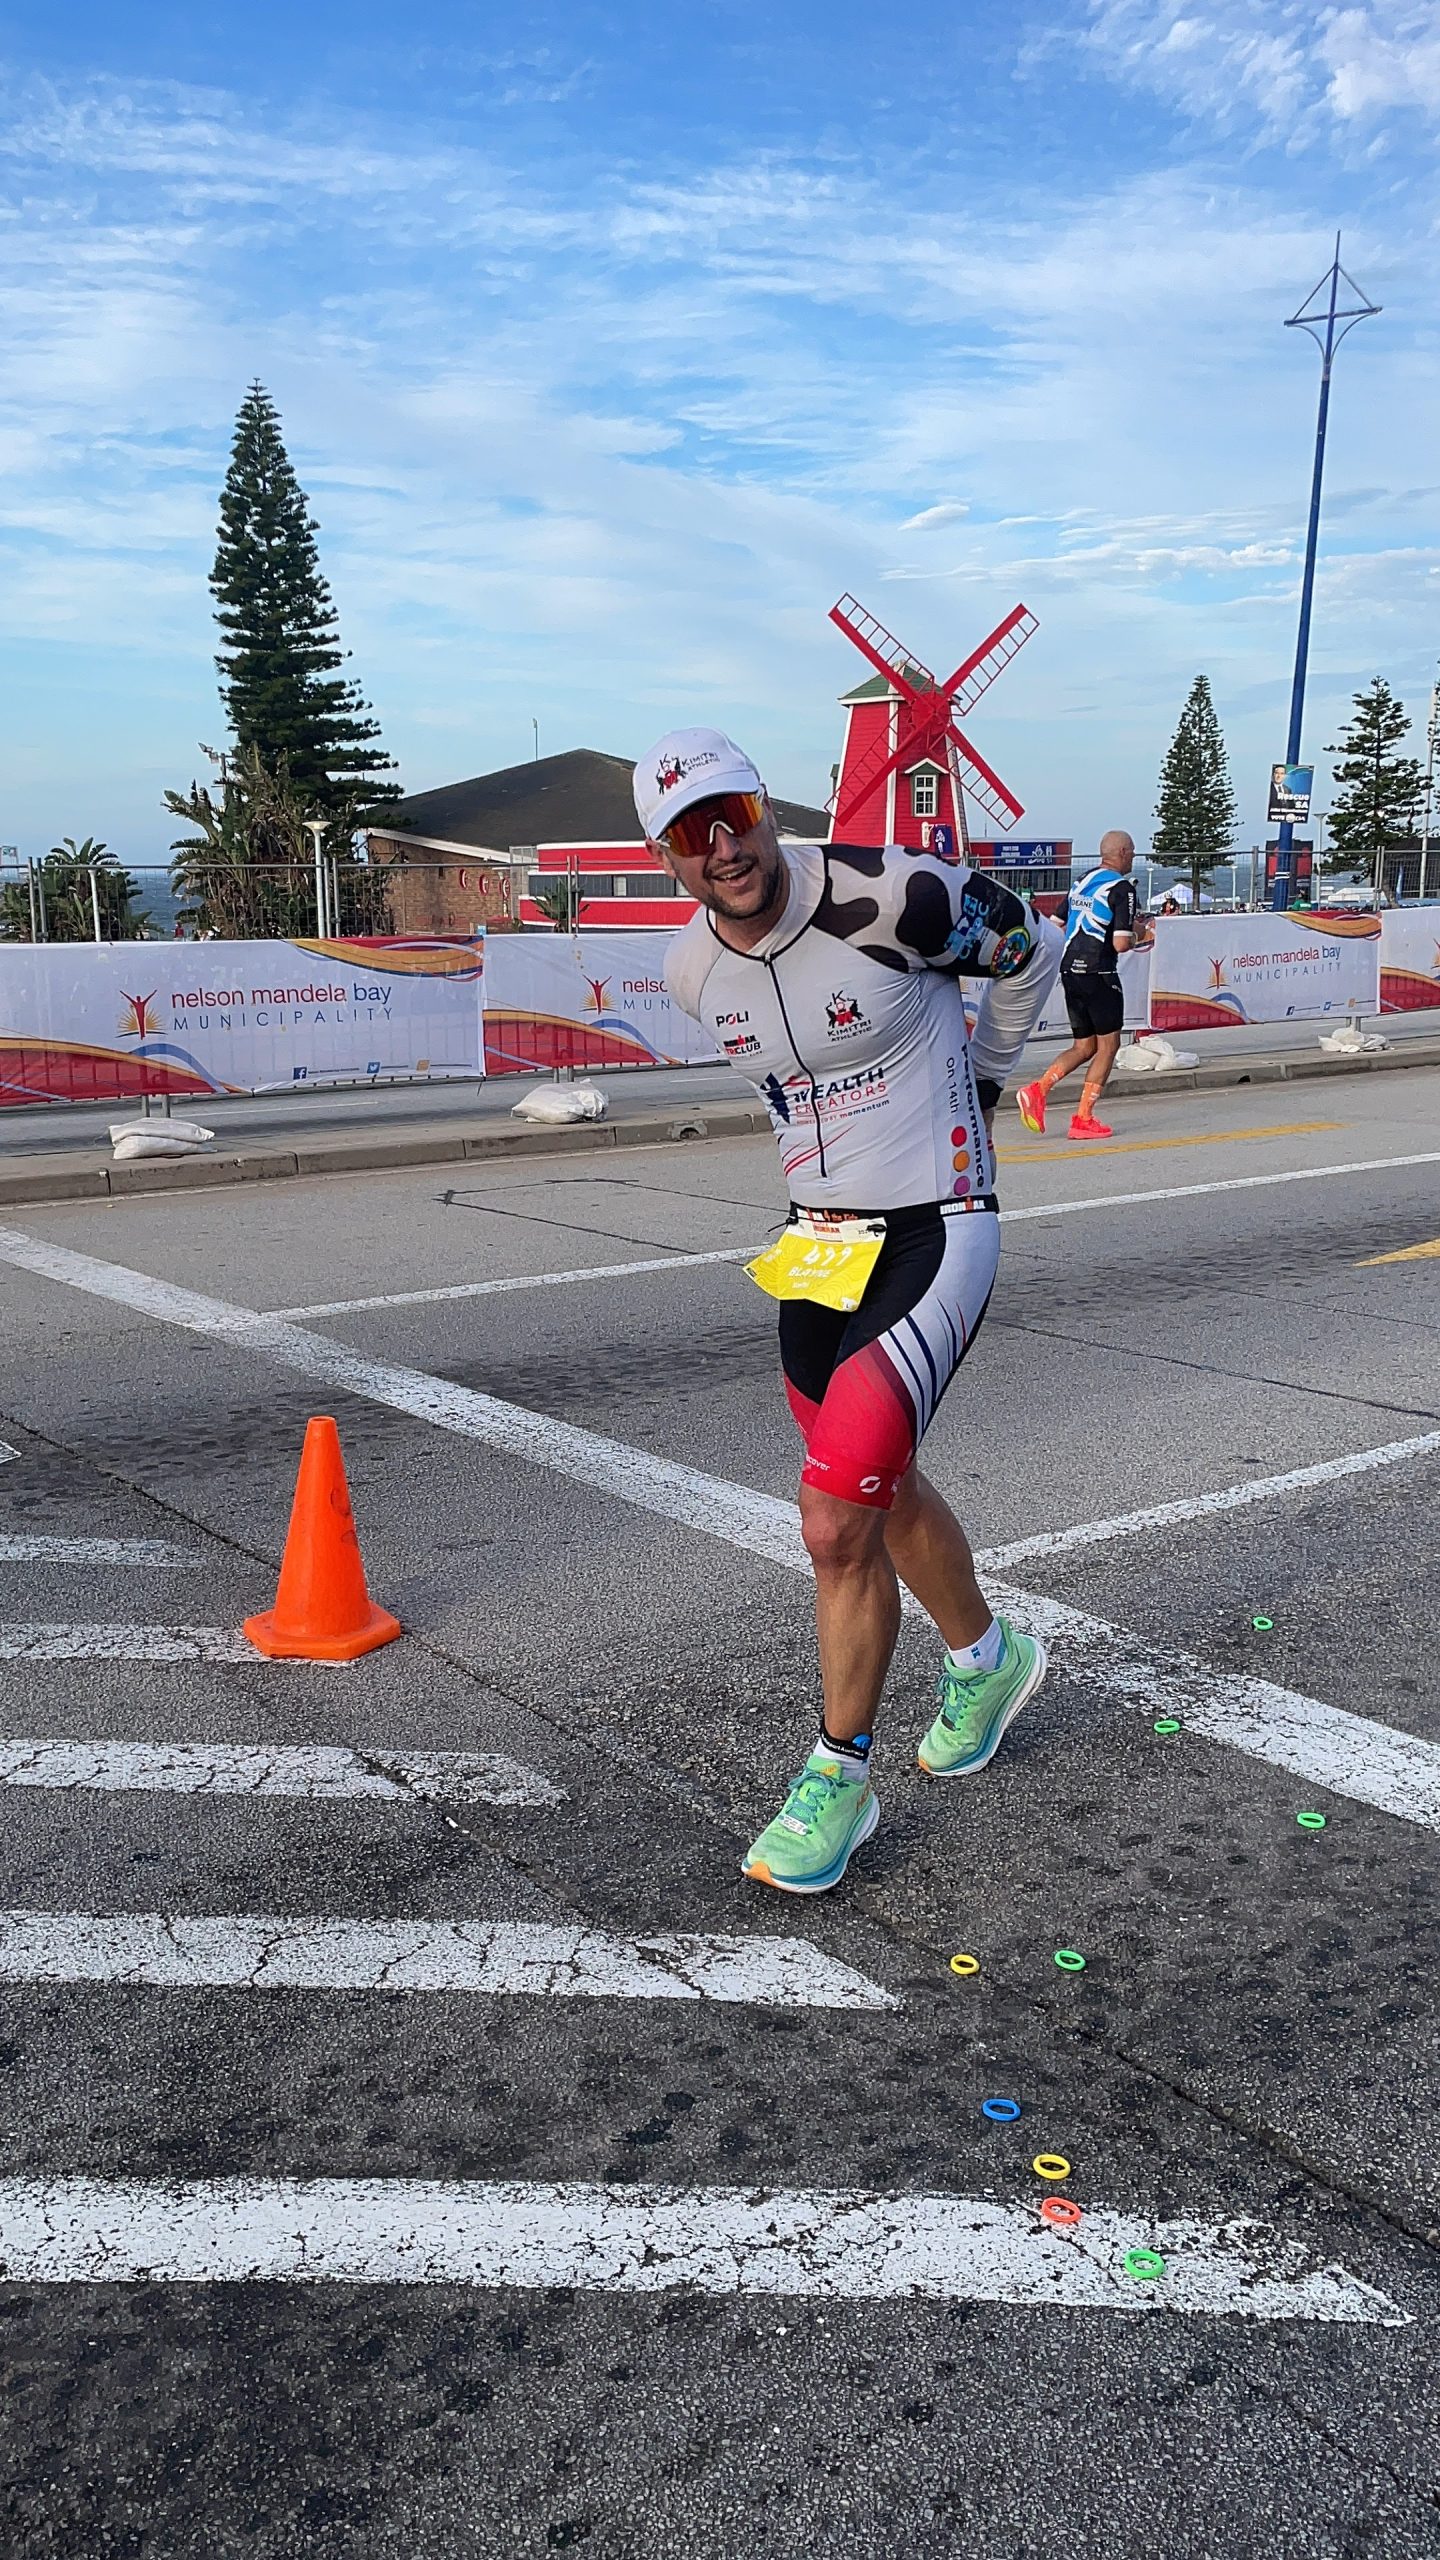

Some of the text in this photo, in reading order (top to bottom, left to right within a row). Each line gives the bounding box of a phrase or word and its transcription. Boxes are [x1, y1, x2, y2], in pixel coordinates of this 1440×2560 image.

[1277, 792, 1309, 801] Rescue
[1295, 801, 1308, 809] SA
[1071, 898, 1092, 908] DEANE
[1233, 945, 1341, 969] nelson mandela bay
[1233, 962, 1341, 983] MUNICIPALITY
[171, 983, 391, 1008] nelson mandela bay
[174, 1007, 392, 1030] MUNICIPALITY
[715, 1010, 749, 1027] POLI
[827, 1019, 872, 1037] KIMITRI
[793, 1067, 884, 1102] WEALTH
[946, 1057, 960, 1114] On 14th
[795, 1081, 887, 1114] CREATORS
[839, 1099, 890, 1119] momentum
[961, 1043, 985, 1188] performance
